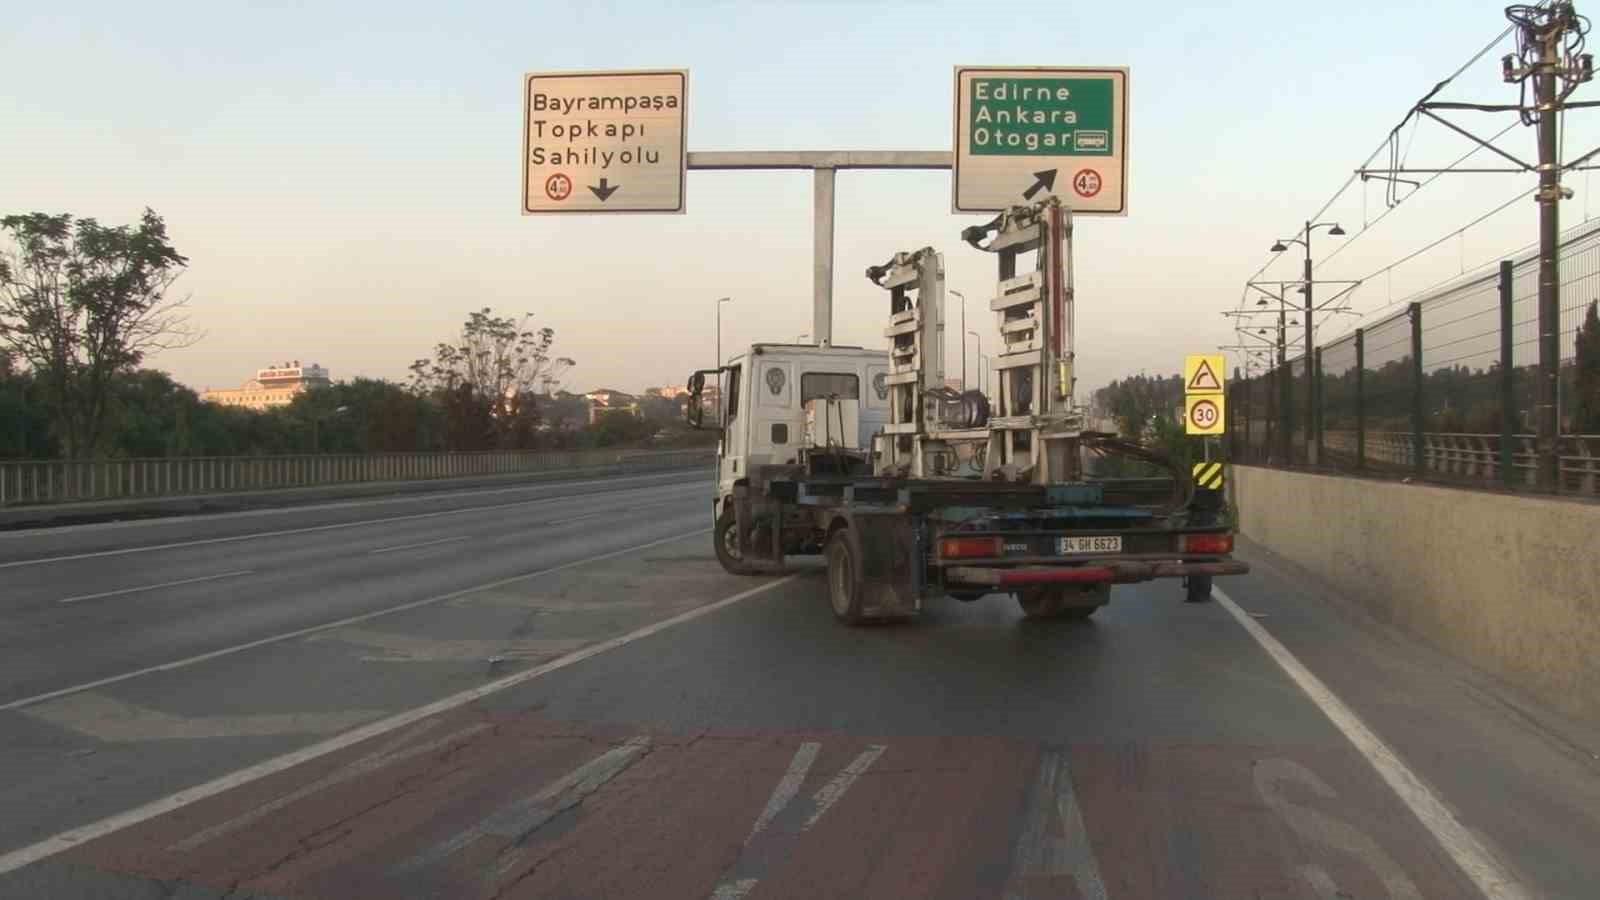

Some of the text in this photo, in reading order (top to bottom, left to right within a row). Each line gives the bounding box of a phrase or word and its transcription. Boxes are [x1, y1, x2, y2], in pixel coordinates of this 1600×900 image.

[976, 82, 1070, 101] Edirne
[533, 93, 678, 116] Bayrampaşa
[975, 105, 1077, 124] Ankara
[534, 120, 645, 142] Topkapı
[974, 127, 1071, 150] Otogar
[532, 147, 659, 169] Sahilyolu
[1196, 408, 1214, 422] 30
[1063, 537, 1119, 551] 34 GH 6623
